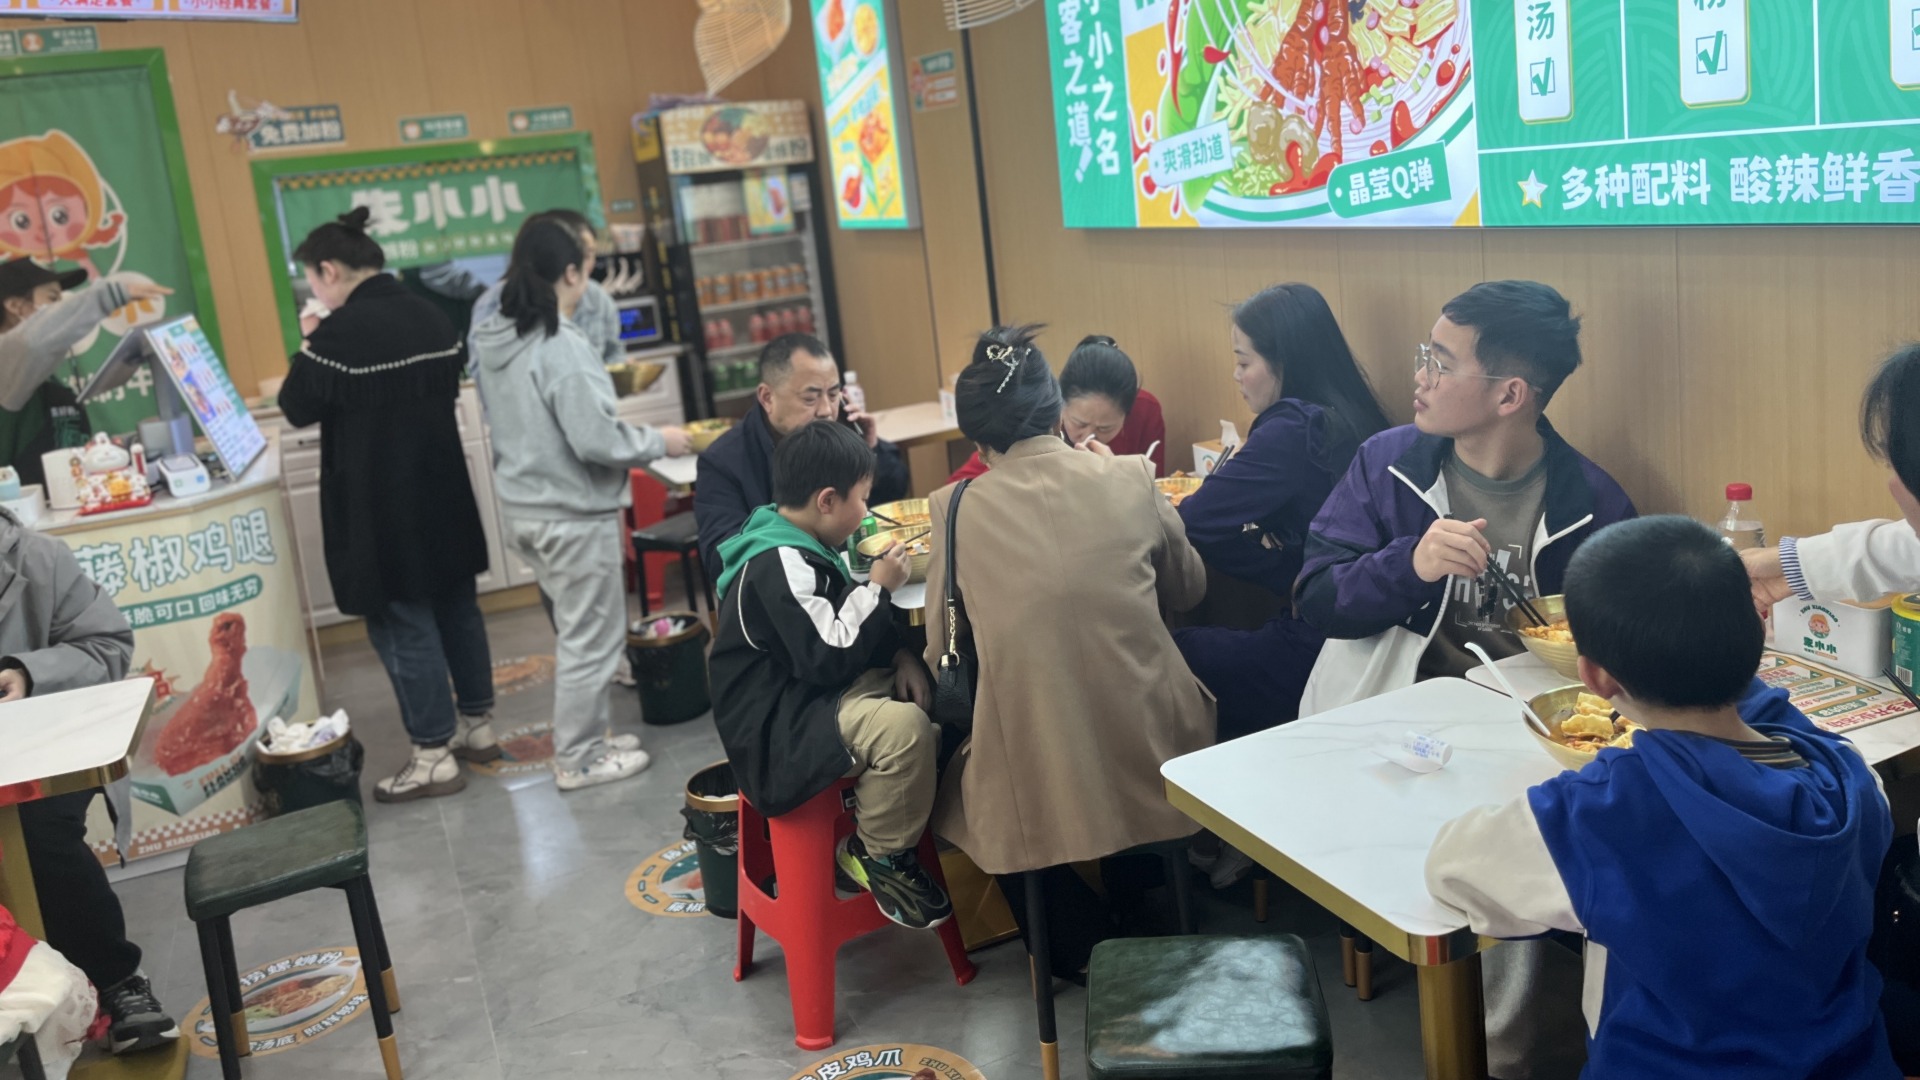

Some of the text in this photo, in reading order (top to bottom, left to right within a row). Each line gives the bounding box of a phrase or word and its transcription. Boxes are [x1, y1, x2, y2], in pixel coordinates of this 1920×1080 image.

[1526, 1, 1554, 40] 汤
[1162, 133, 1225, 174] 爽滑劲道
[1348, 157, 1434, 207] 晶莹Q弹
[1561, 148, 1920, 210] 多种配料 酸辣鲜香
[75, 508, 276, 597] 藤椒鸡腿
[198, 578, 258, 614] 回味无穷
[138, 843, 162, 855] ZHU
[919, 1057, 949, 1071] ZHU
